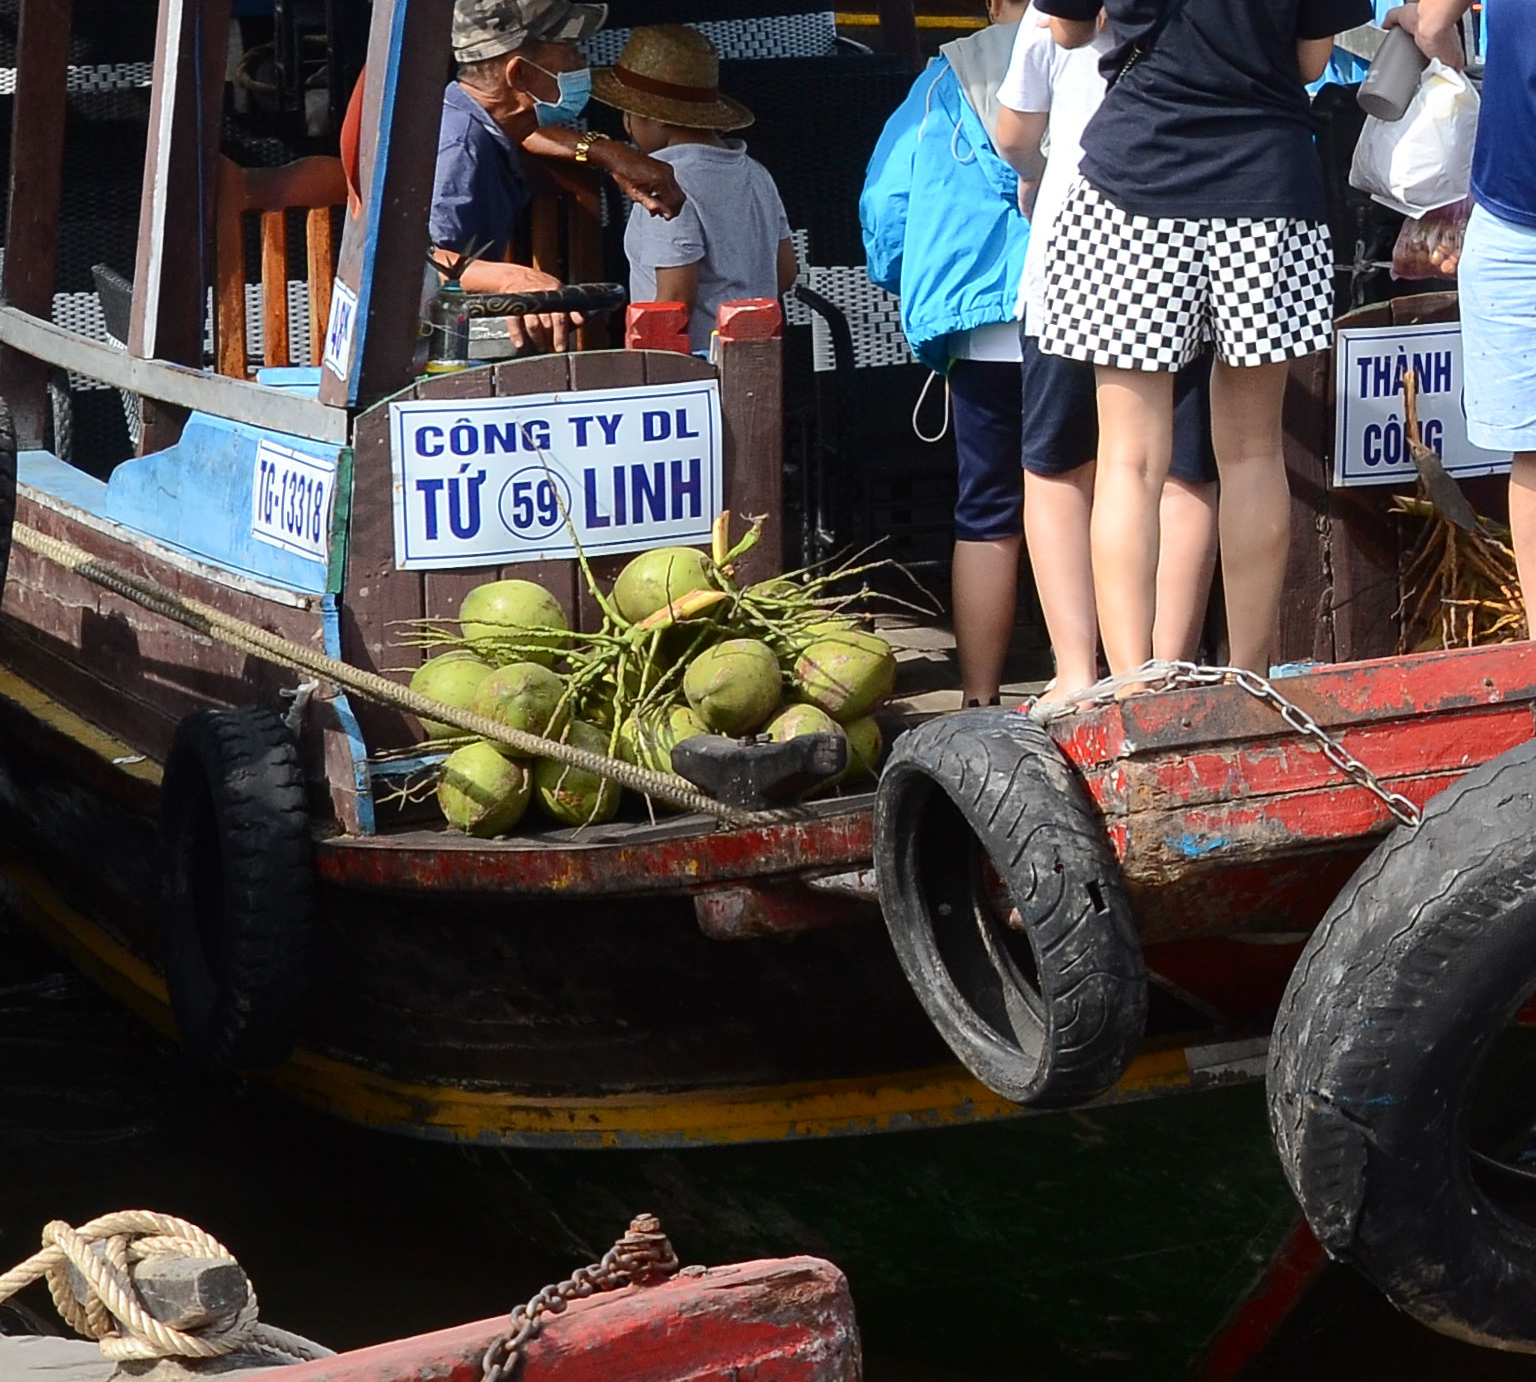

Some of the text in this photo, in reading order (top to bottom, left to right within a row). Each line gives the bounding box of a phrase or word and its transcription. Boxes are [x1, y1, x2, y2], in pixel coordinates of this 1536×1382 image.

[1356, 345, 1452, 399] THÀNH
[414, 408, 699, 457] CÔNG TY DL
[258, 459, 324, 544] TG-13318
[415, 458, 702, 540] TỨ 59 LINH
